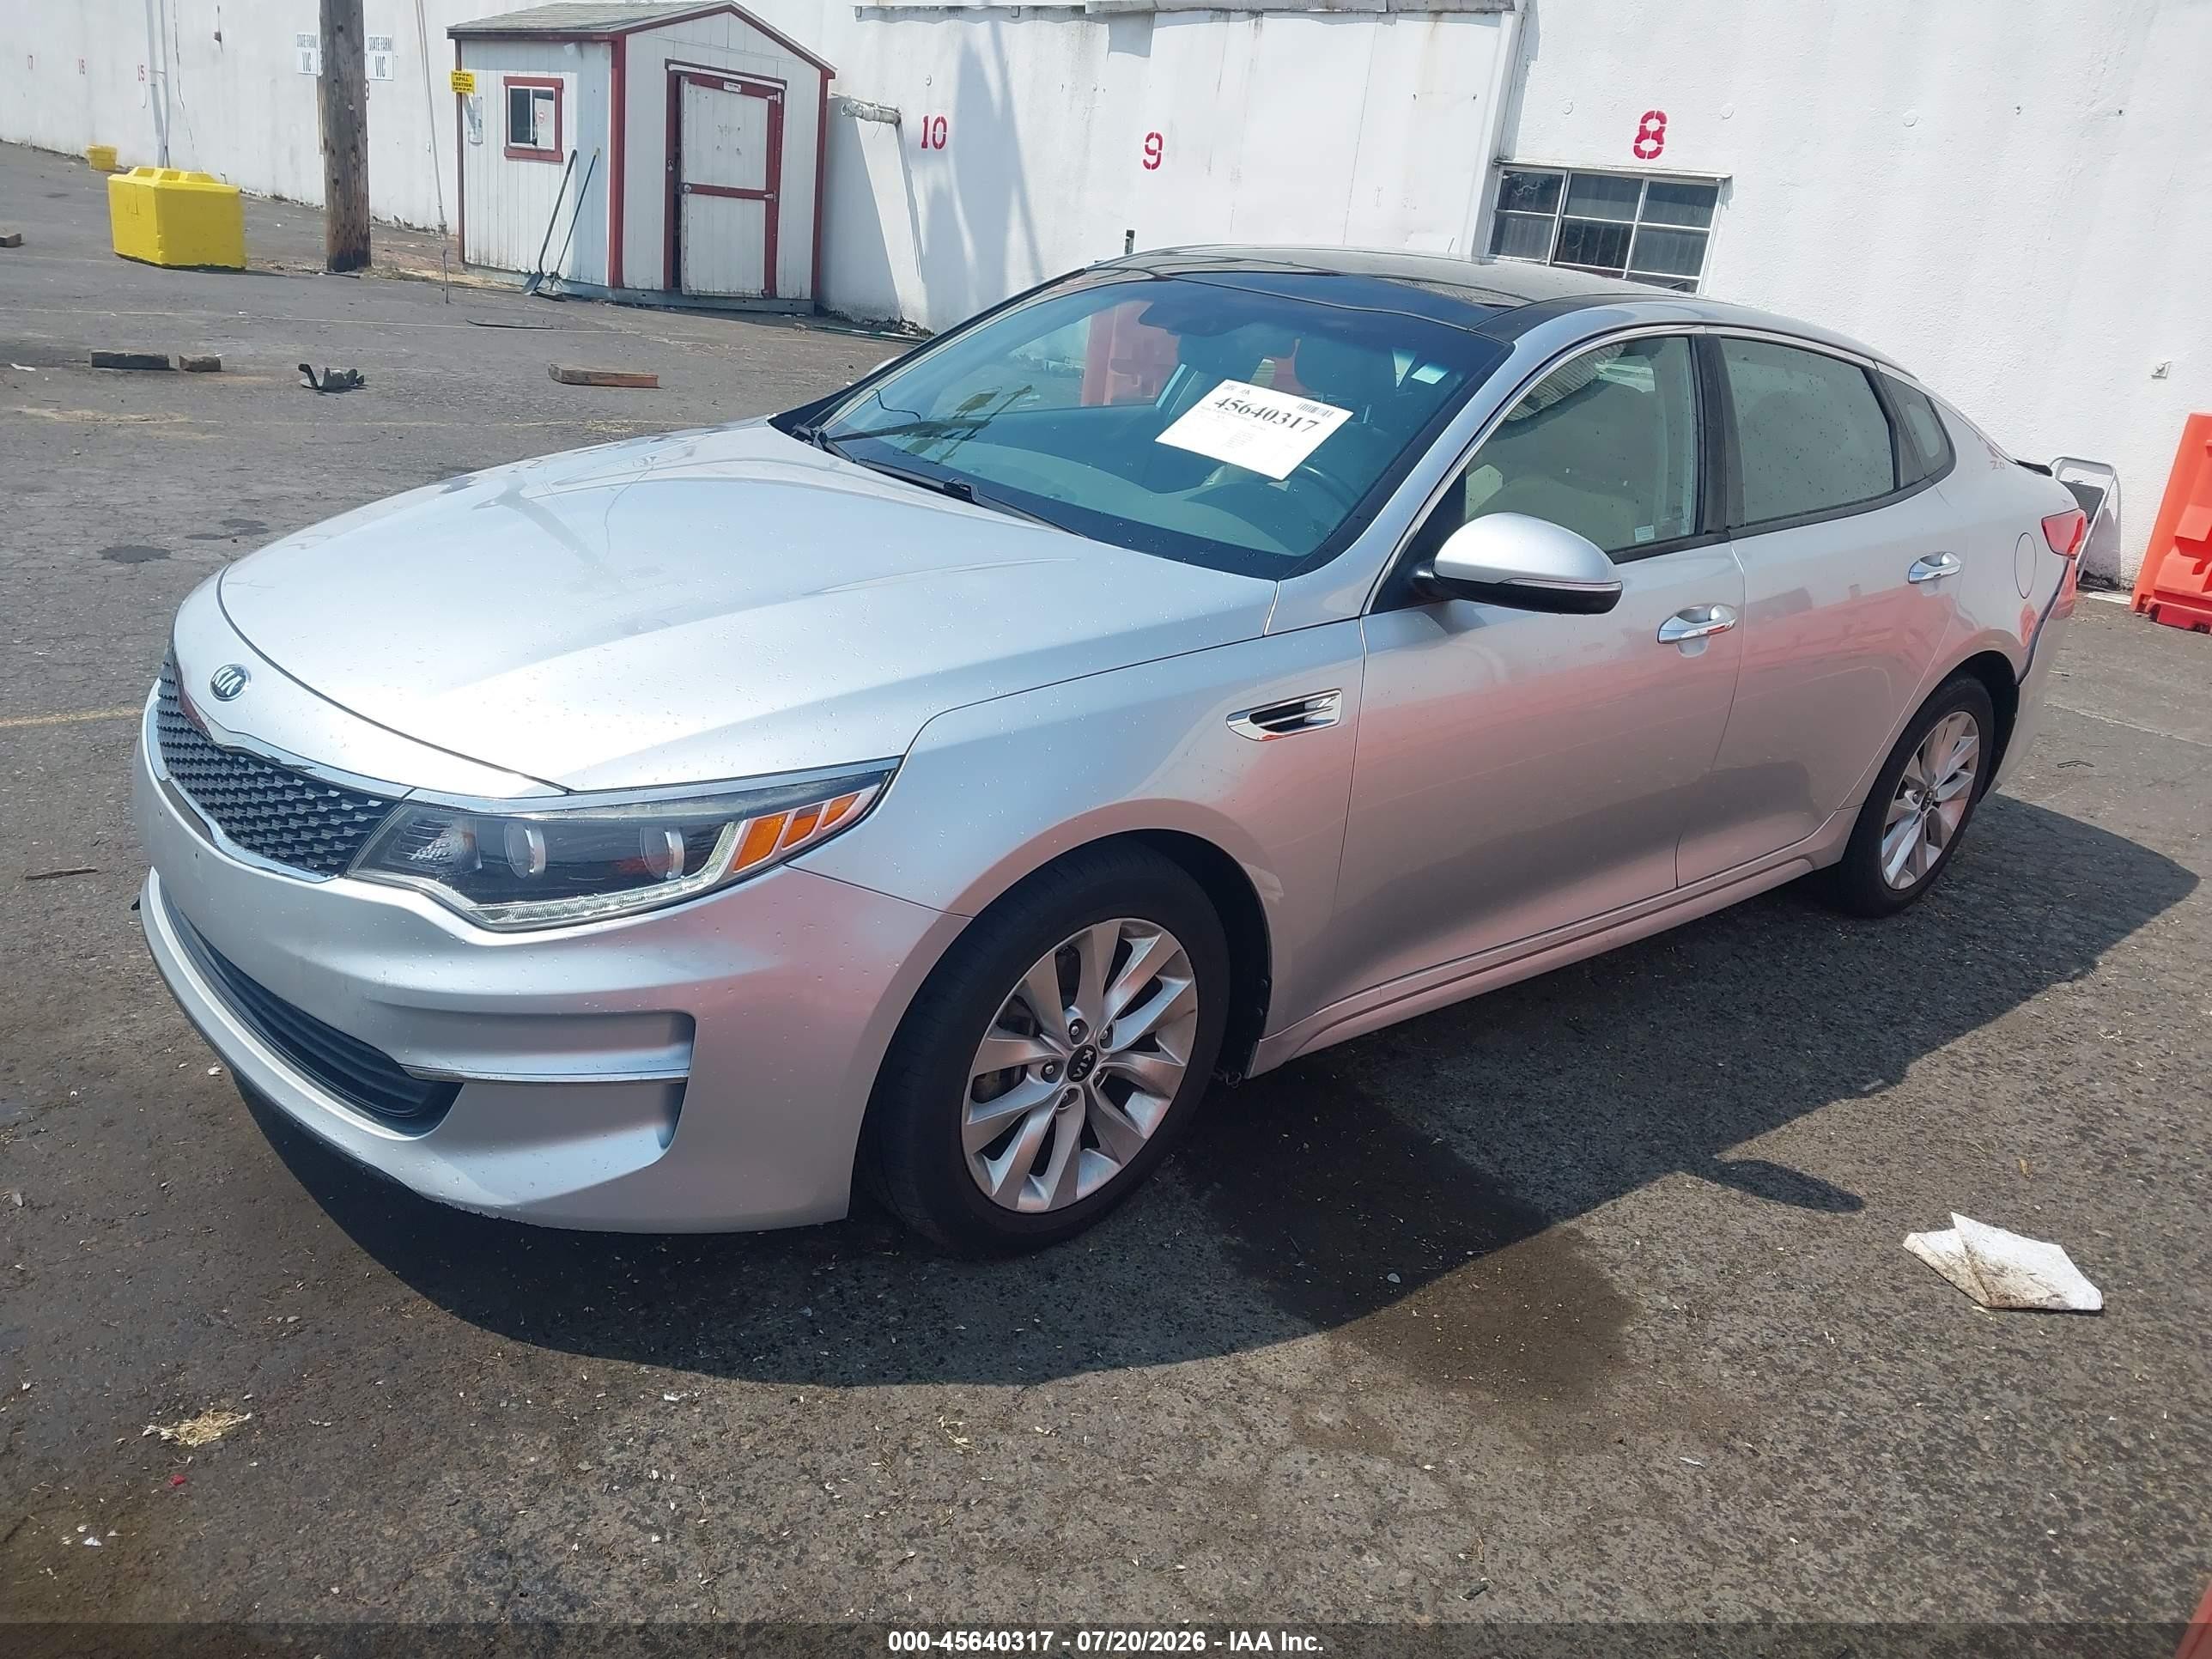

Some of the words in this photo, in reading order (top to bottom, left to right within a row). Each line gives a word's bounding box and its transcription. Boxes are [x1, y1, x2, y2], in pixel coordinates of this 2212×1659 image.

[368, 36, 380, 52] STATE
[380, 36, 392, 52] FARM
[137, 64, 145, 82] 15
[301, 52, 312, 72] VIC
[374, 56, 386, 77] VIC
[921, 115, 947, 149] 10
[1633, 110, 1668, 160] 8
[1142, 131, 1163, 170] 9
[1214, 397, 1320, 433] 45640317
[211, 665, 243, 696] KIA
[1072, 1049, 1094, 1078] KIA
